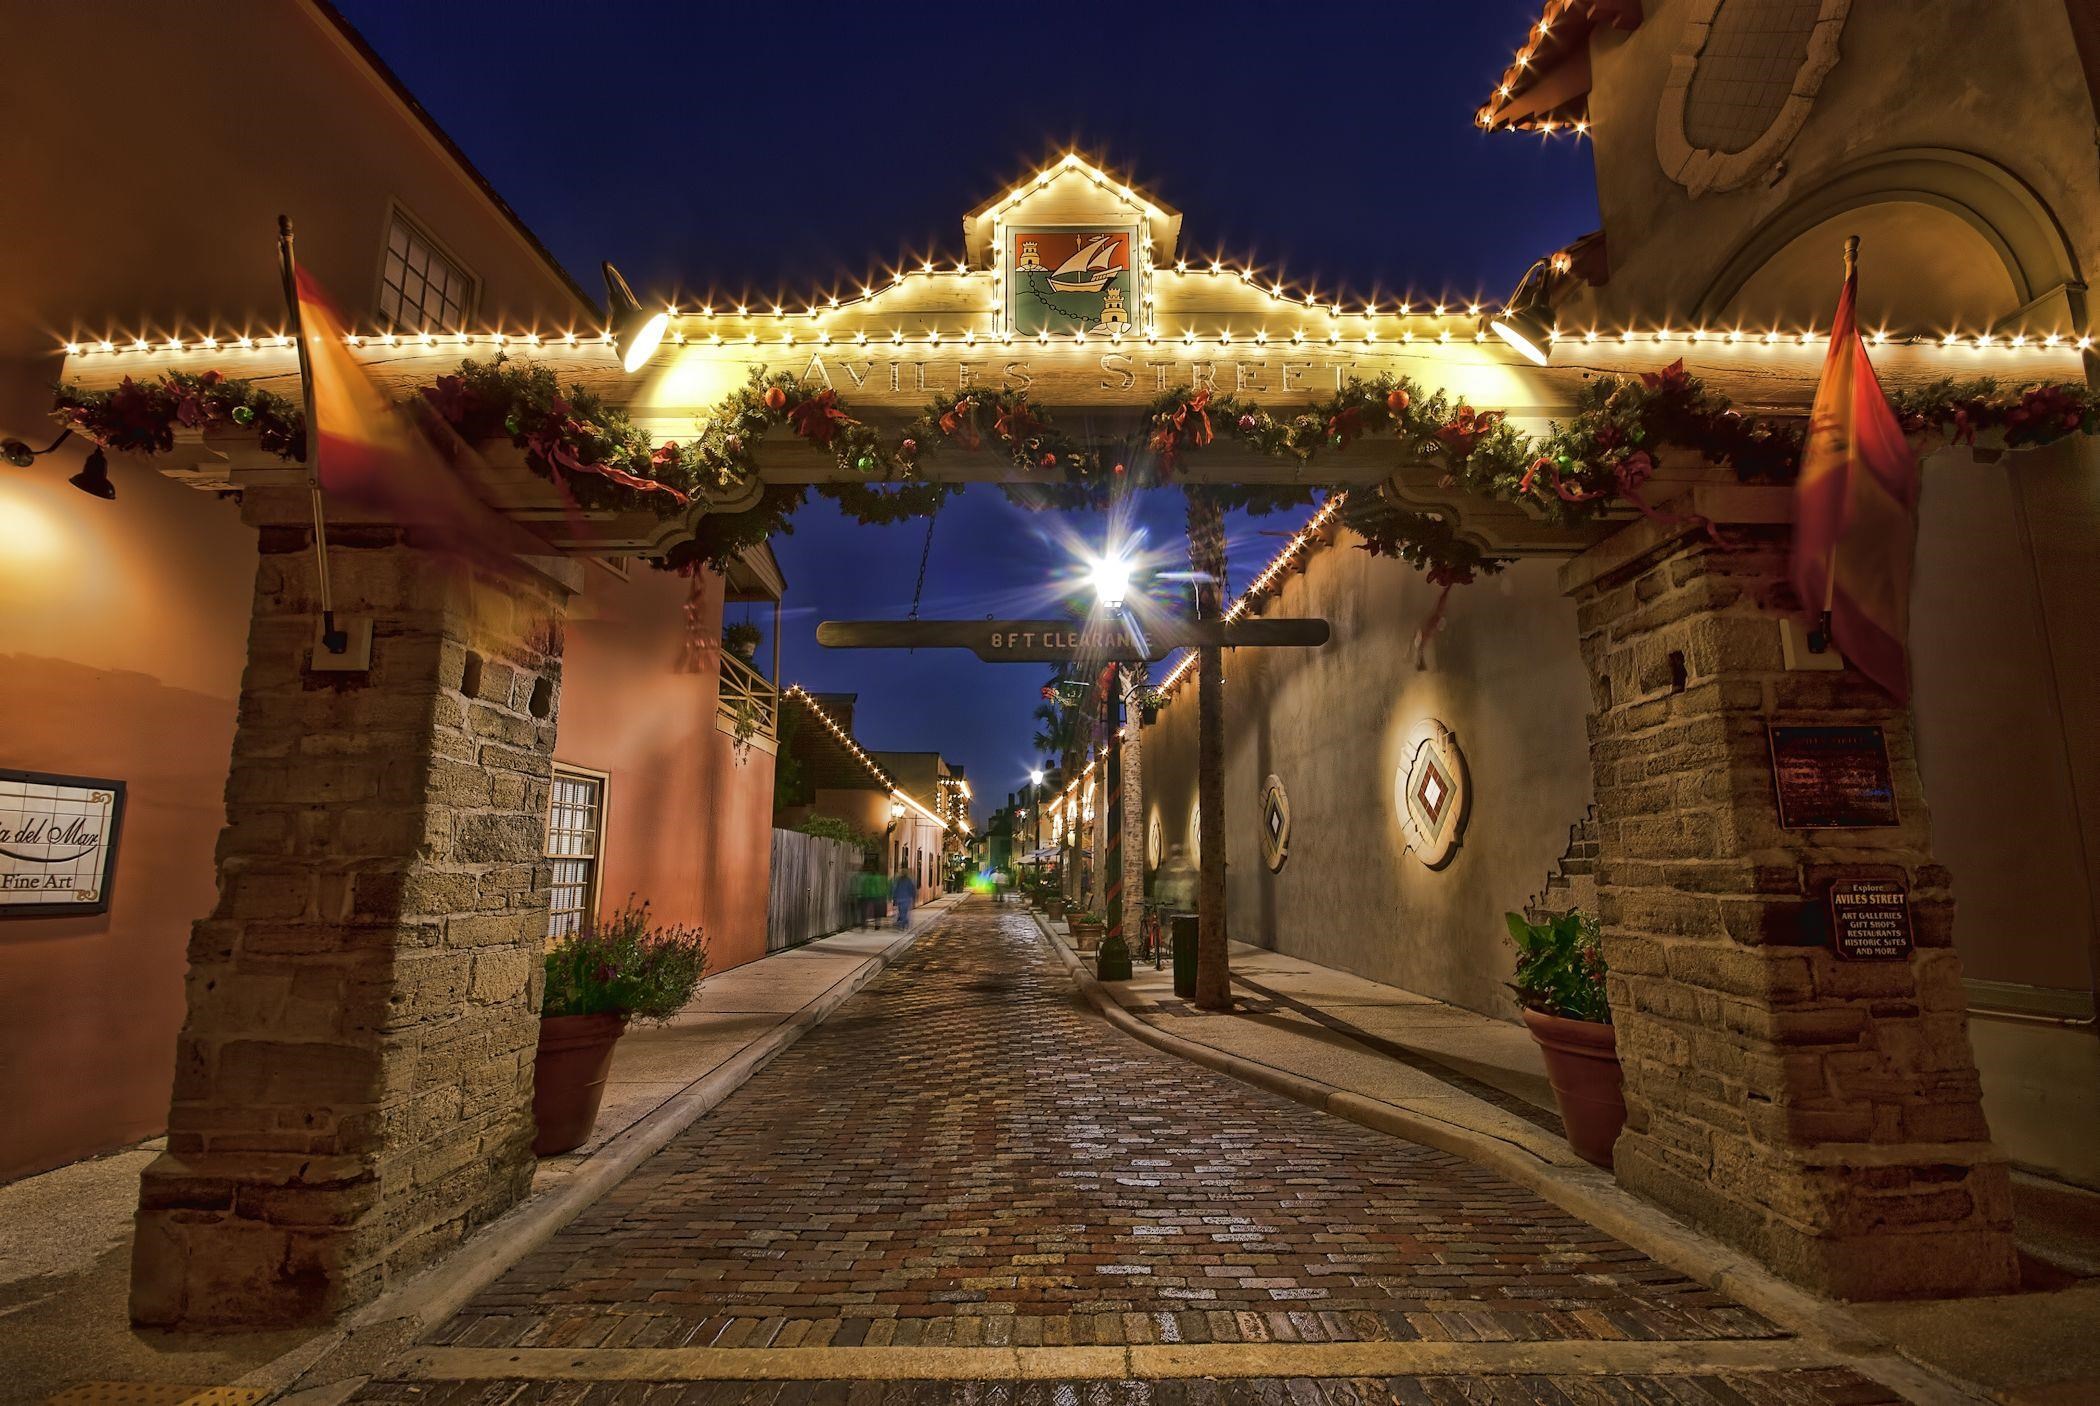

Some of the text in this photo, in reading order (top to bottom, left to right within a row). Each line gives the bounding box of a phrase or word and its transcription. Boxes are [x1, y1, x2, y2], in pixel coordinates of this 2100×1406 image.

[798, 352, 1357, 393] AVILES STREET
[1043, 632, 1153, 648] CLEARANE
[14, 818, 48, 843] del
[48, 817, 99, 845] Mar
[3, 874, 73, 889] Fine Art
[1835, 894, 1904, 905] AVILES STREET
[1841, 912, 1902, 920] ART GALLERIES
[1845, 938, 1881, 946] HISTORIC
